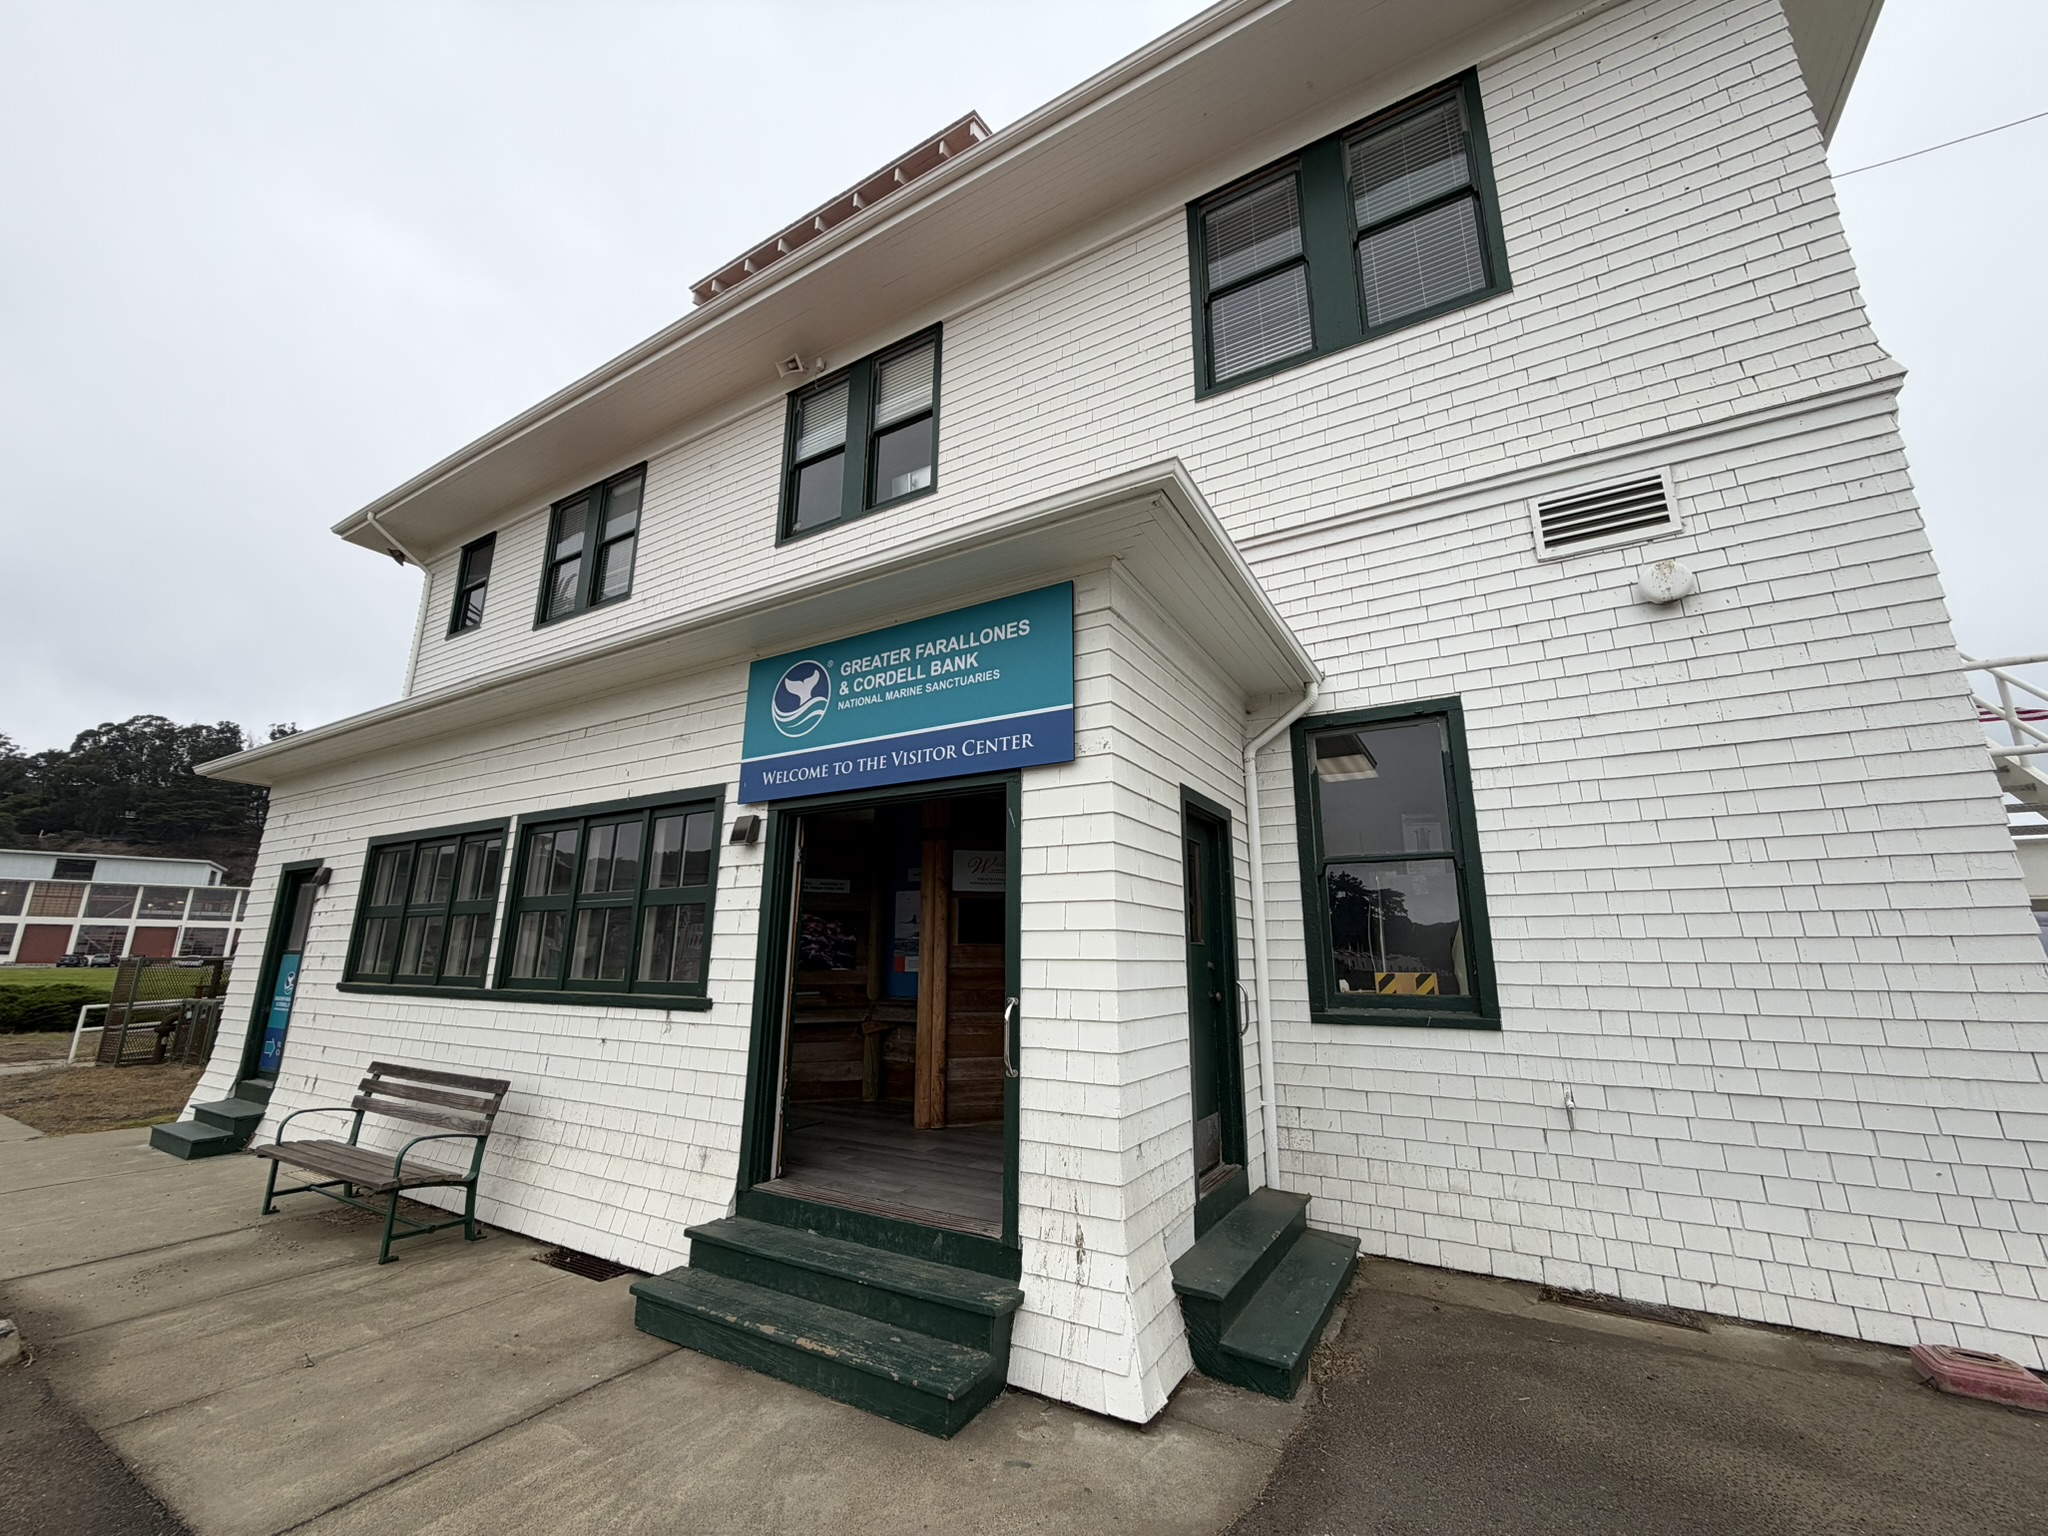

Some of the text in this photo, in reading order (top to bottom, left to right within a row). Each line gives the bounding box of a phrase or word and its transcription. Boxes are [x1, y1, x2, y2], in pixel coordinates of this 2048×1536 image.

[840, 619, 1031, 676] GREATER FARALLONES
[837, 669, 1001, 711] NATIONAL MARINE SANCTUARIES
[838, 651, 979, 696] & CORDELL BANK
[762, 733, 1035, 785] WELCOME TO THE VISITOR CENTER
